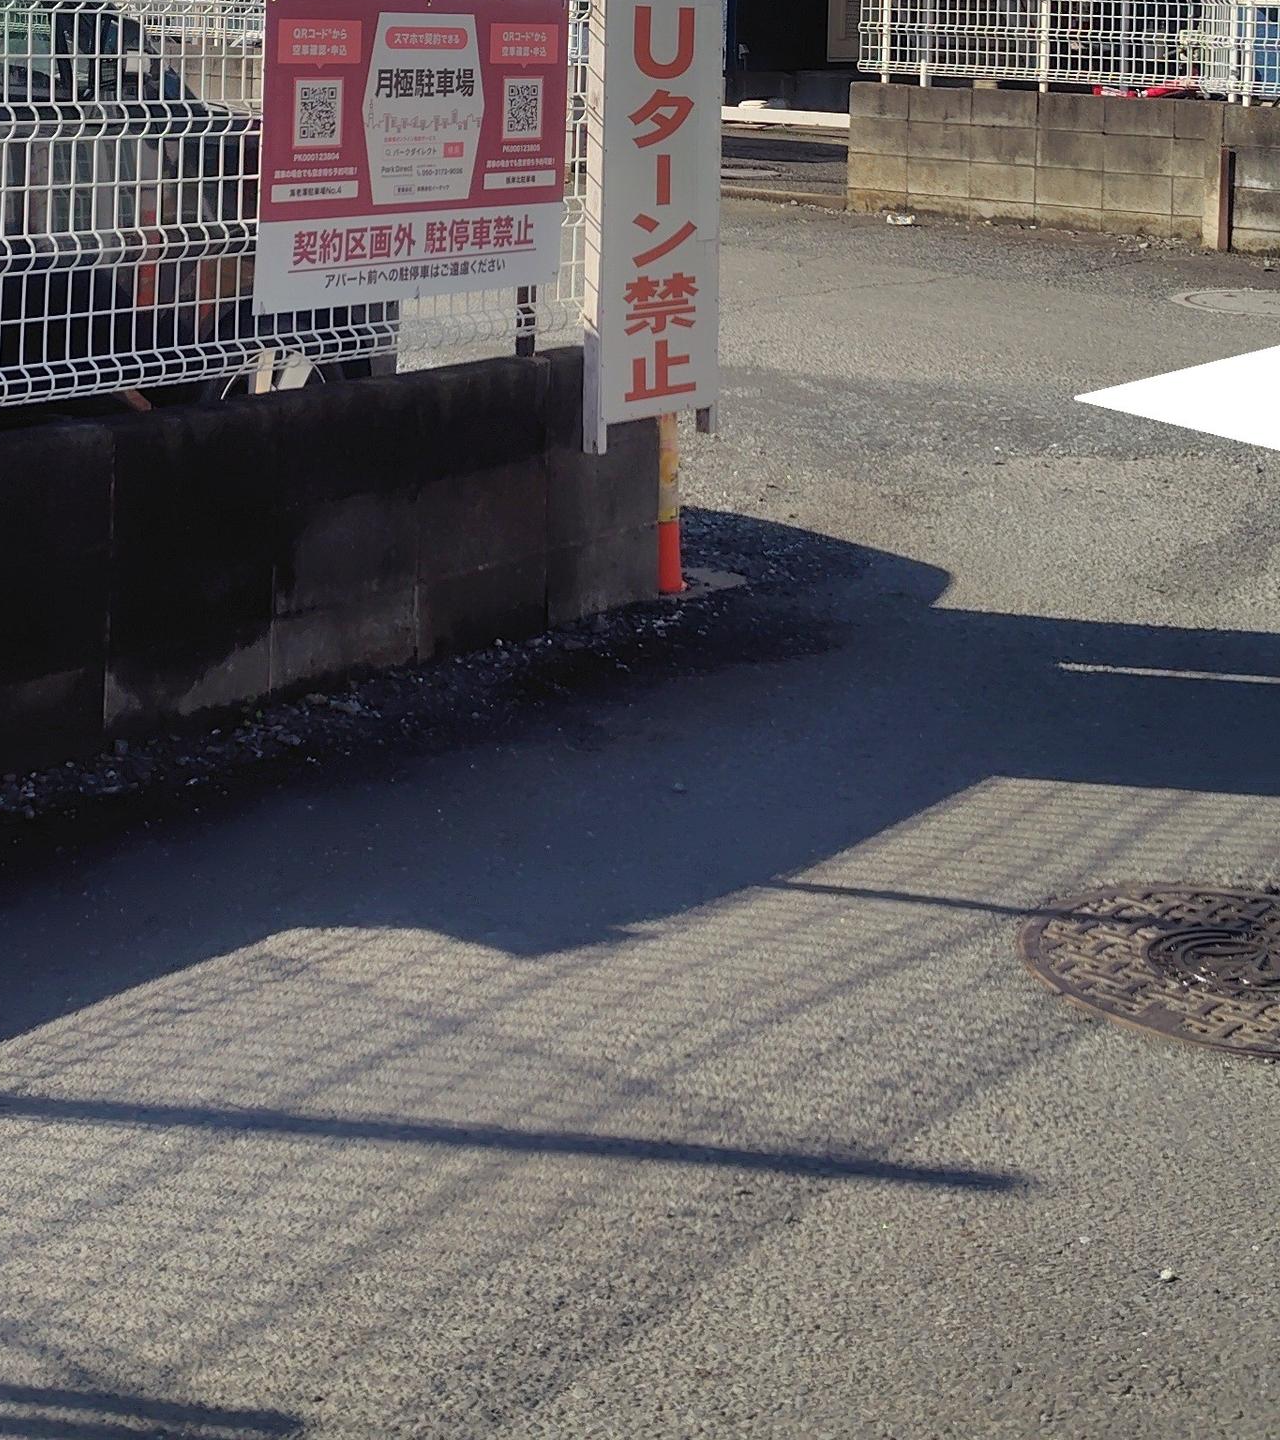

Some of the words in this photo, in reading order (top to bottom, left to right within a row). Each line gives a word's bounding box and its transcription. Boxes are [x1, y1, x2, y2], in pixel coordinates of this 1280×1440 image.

[375, 68, 475, 98] 月極駐車場
[624, 5, 699, 402] Uターン禁止
[292, 222, 416, 266] 契約区画外
[424, 214, 535, 254] 駐停車禁止
[324, 258, 506, 289] アパート前への駐停車はご遠慮ください
